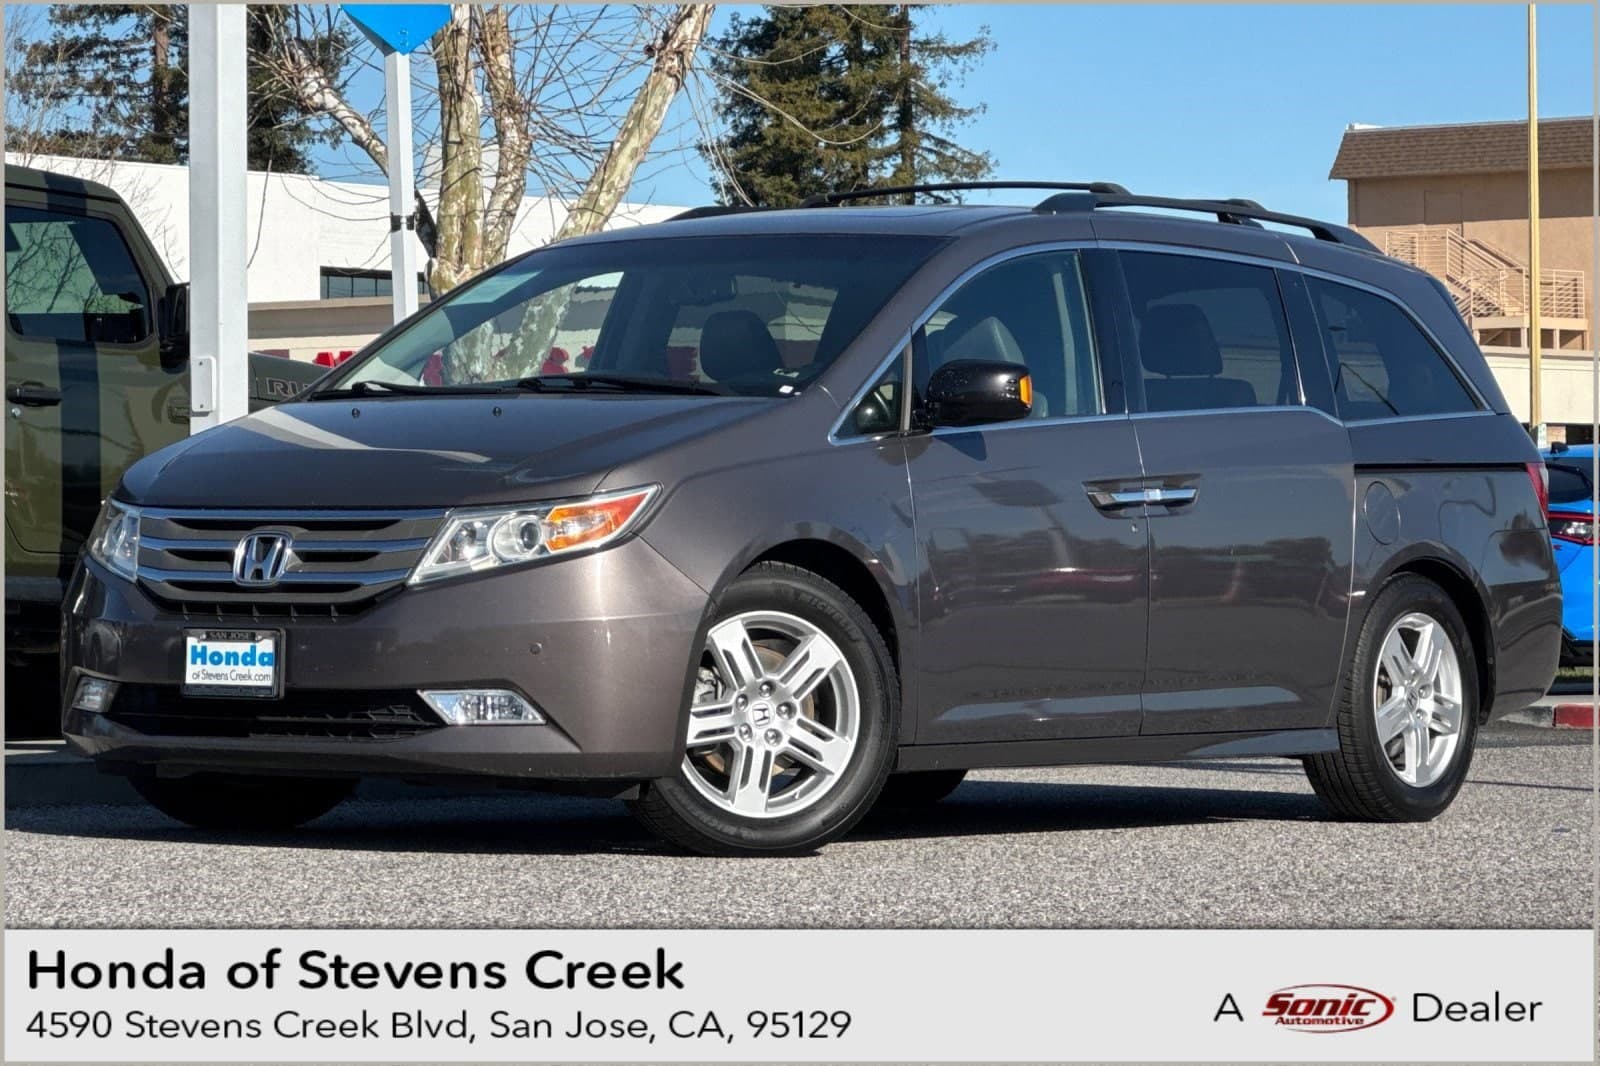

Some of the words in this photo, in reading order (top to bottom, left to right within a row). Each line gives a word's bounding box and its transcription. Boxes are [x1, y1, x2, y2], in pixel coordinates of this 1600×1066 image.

[210, 632, 227, 640] SAN
[191, 645, 273, 666] Honda
[192, 670, 201, 680] of
[201, 669, 229, 681] Stevens
